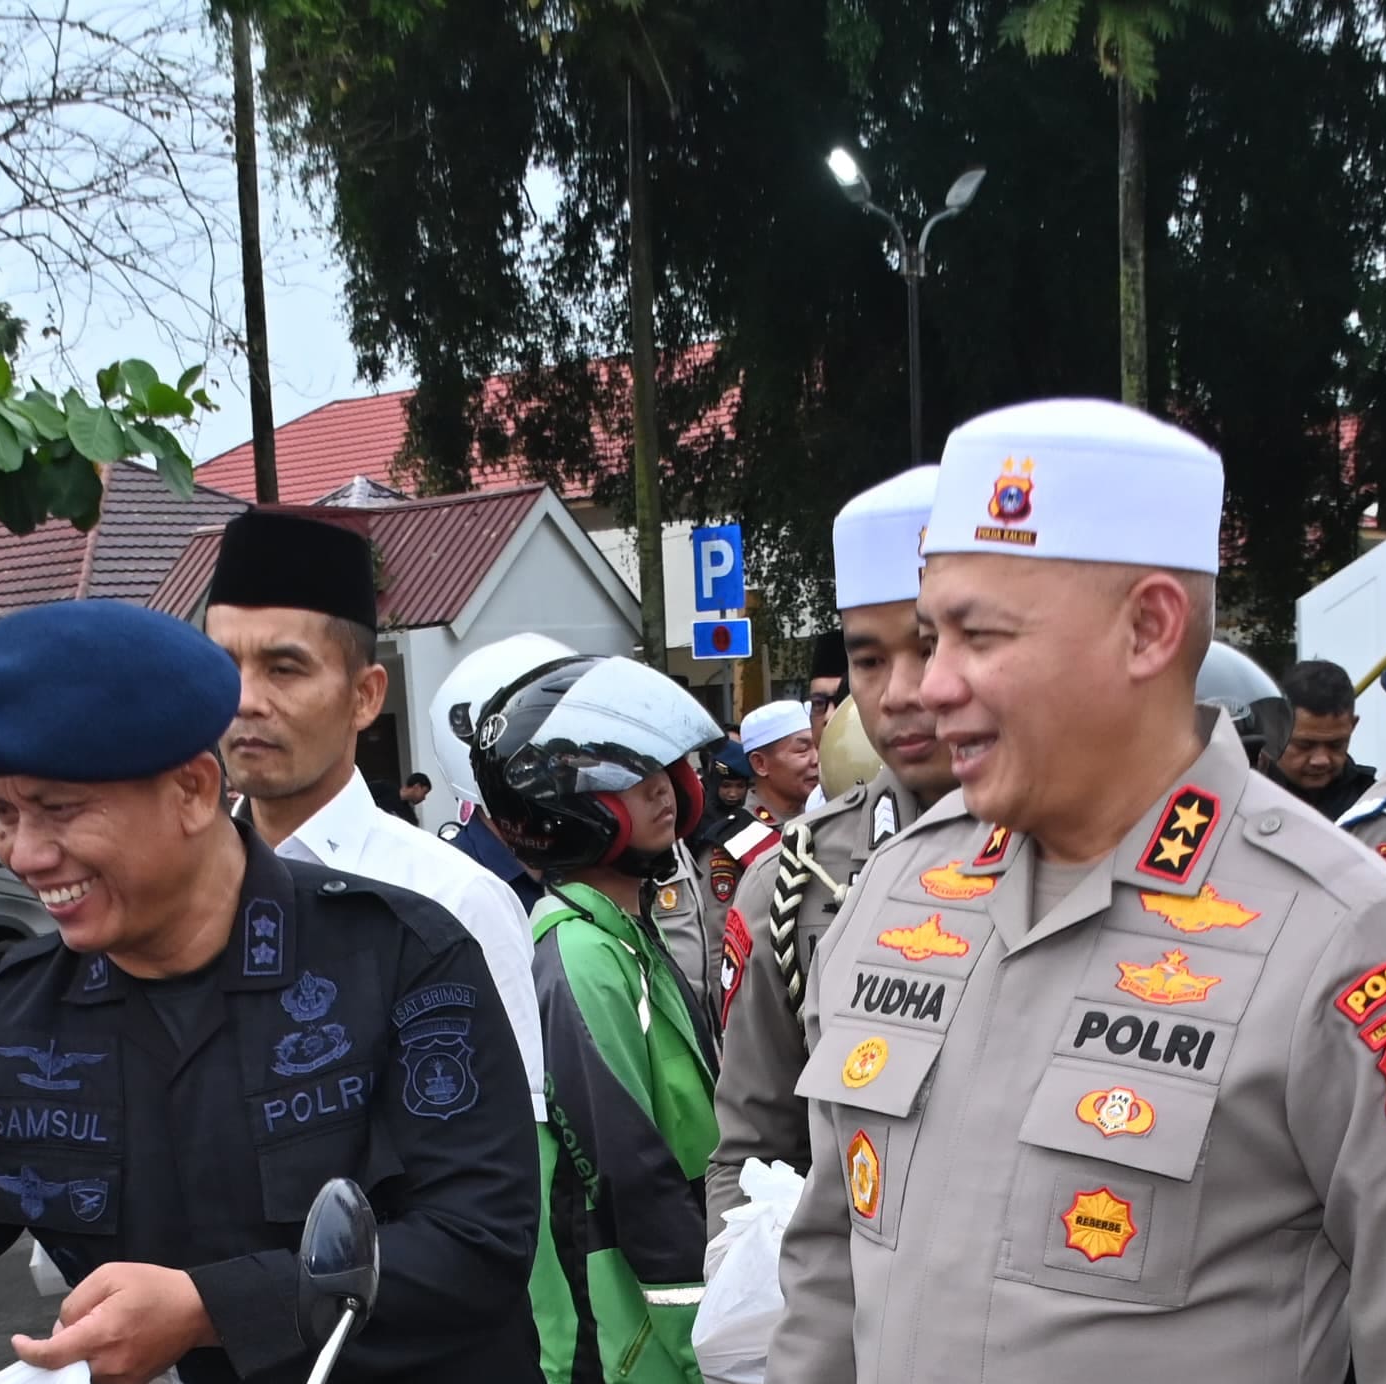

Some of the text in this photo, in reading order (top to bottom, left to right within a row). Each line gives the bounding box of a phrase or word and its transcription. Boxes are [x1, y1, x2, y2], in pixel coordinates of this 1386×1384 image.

[700, 539, 735, 599] P
[395, 988, 471, 1020] SAT BRIMOB
[850, 972, 947, 1023] YUDHA
[1074, 1010, 1216, 1071] POLRI
